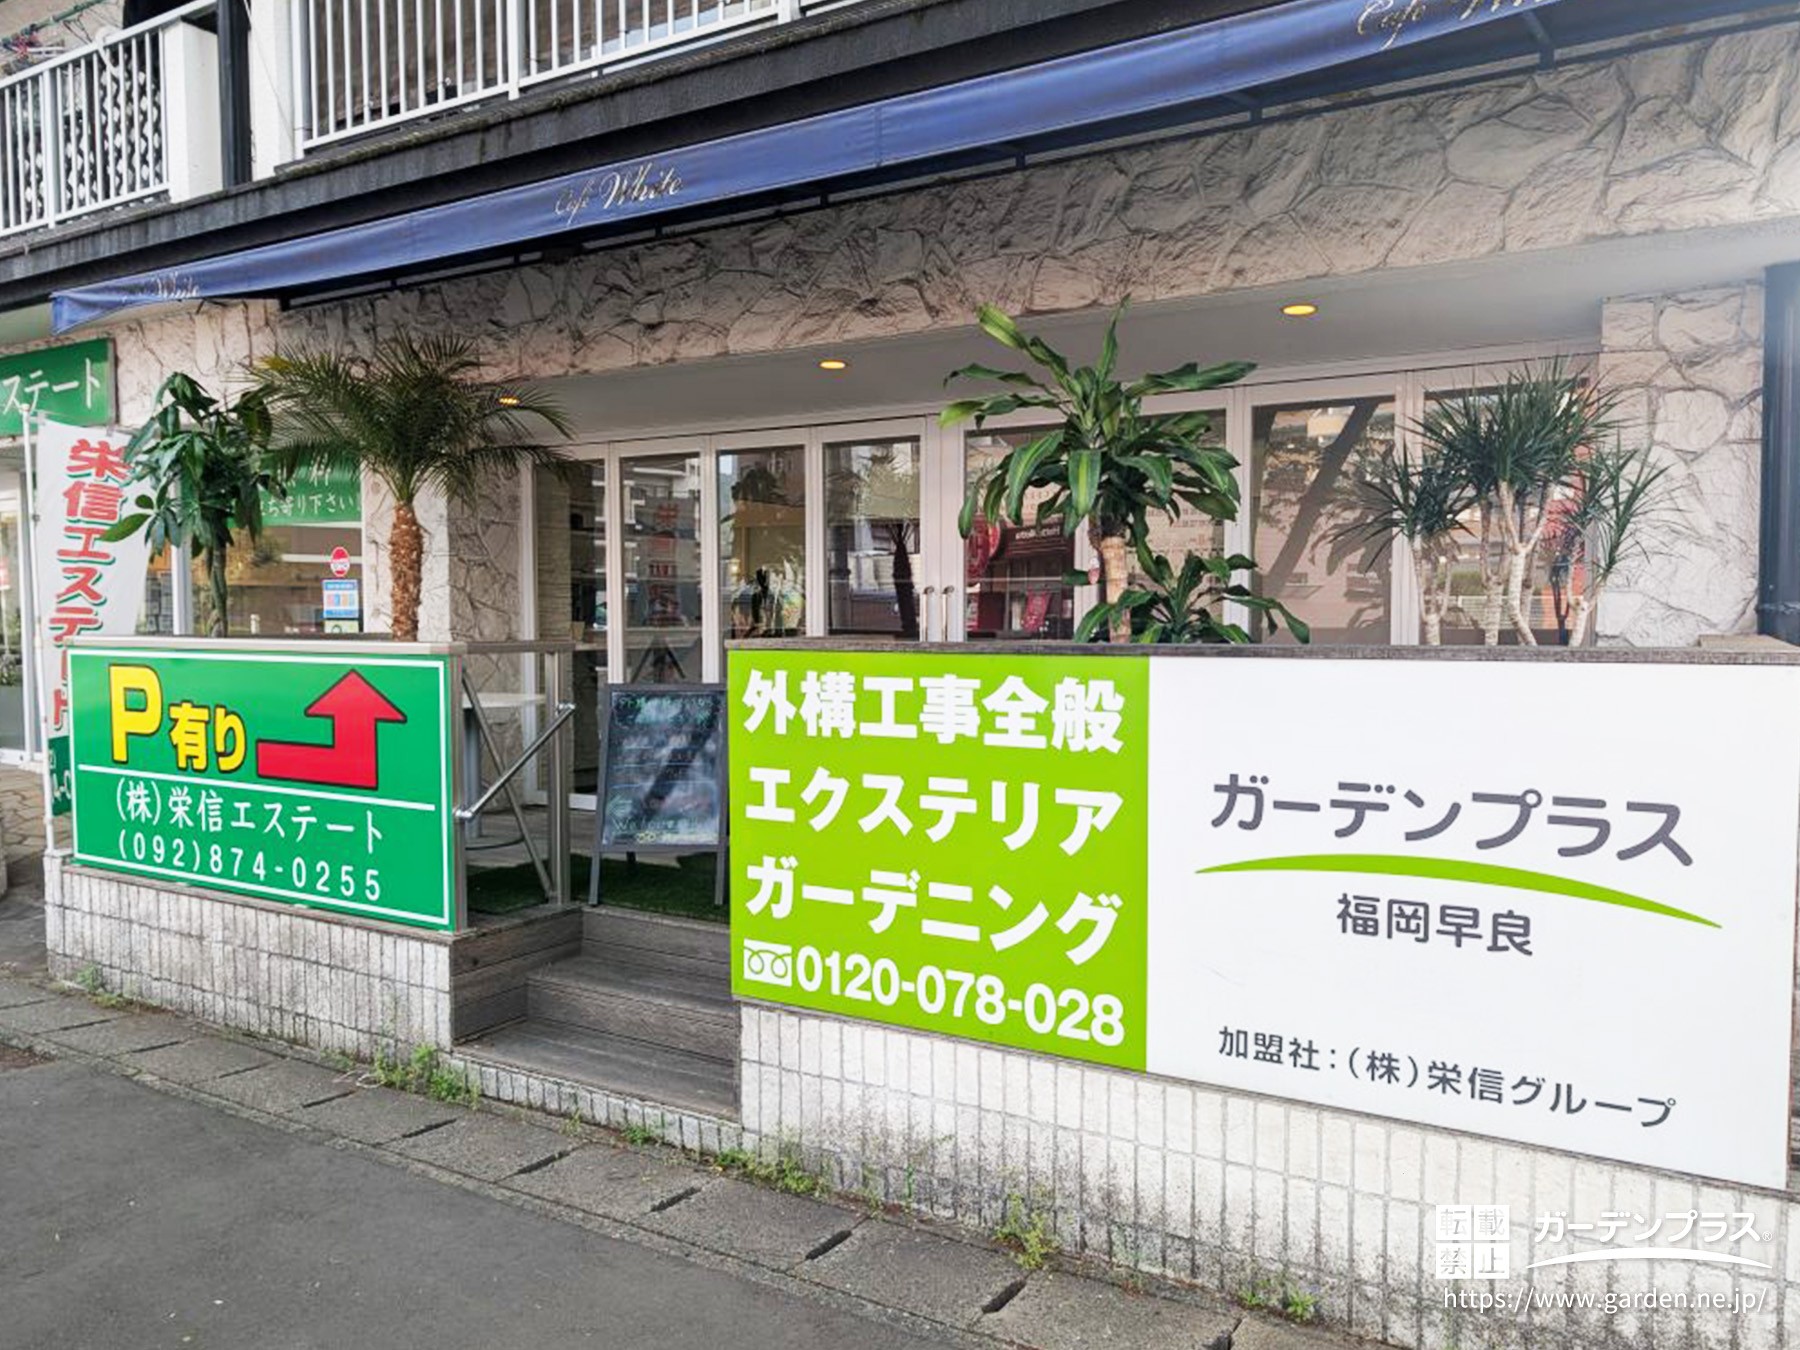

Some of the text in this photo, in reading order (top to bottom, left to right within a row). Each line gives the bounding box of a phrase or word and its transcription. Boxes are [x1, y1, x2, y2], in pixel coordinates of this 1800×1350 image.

[600, 162, 683, 209] White
[2, 357, 101, 413] ステート
[108, 663, 247, 774] P有り
[741, 669, 1125, 754] 外構工事全般
[115, 777, 383, 856] (株)栄信エステート
[745, 766, 1124, 857] エクステリア
[1210, 773, 1693, 867] ガーデンプラス
[117, 829, 382, 902] (092)874-0255
[745, 855, 1123, 967] ガーデニング
[1336, 892, 1534, 957] 福岡早良
[795, 945, 1126, 1048] 0120-078-028
